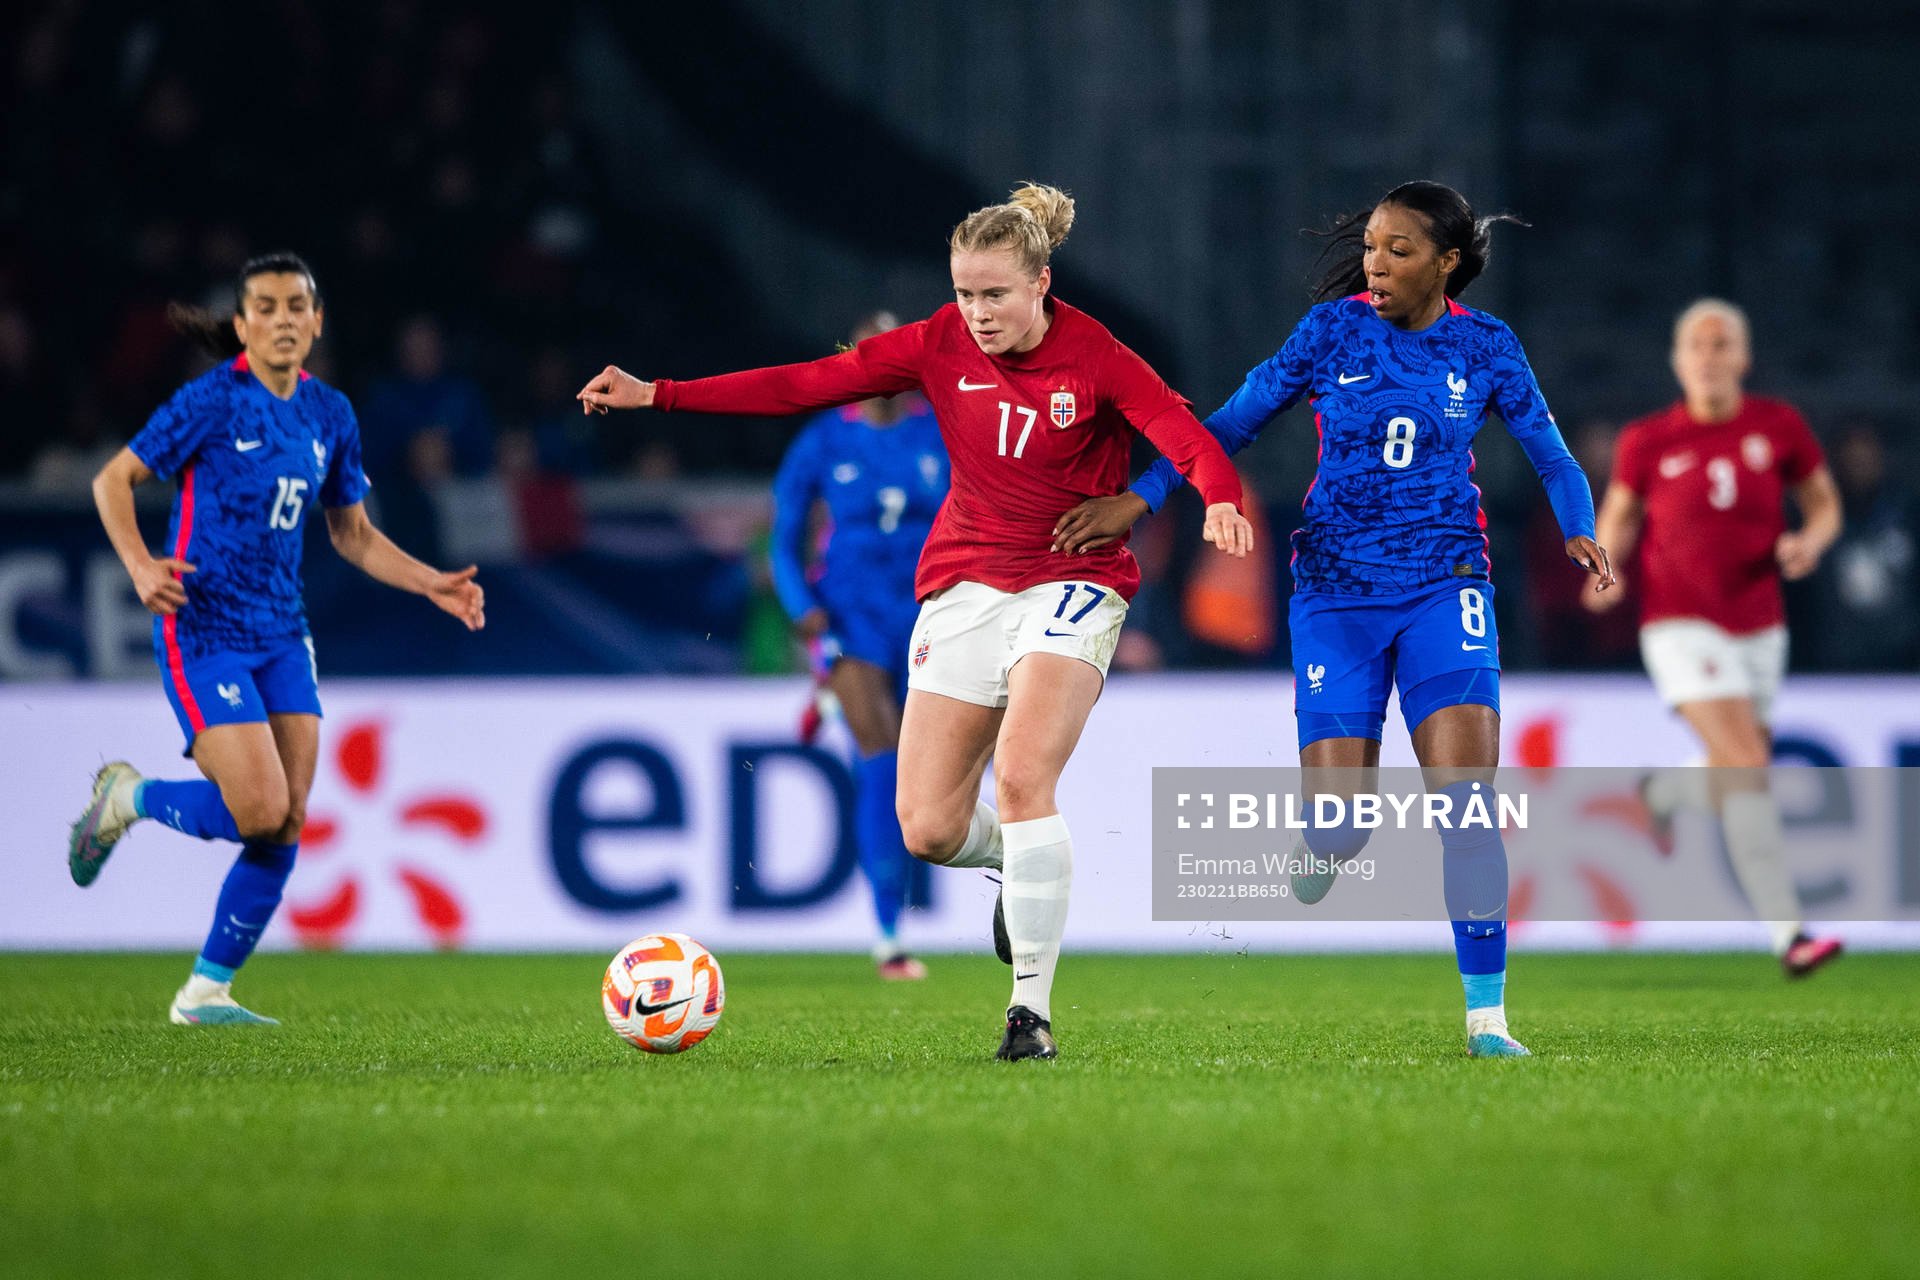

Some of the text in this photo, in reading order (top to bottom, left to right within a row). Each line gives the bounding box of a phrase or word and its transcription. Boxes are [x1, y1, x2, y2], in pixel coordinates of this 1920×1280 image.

[998, 401, 1038, 459] 17
[1383, 416, 1416, 468] 8
[269, 476, 308, 530] 15
[878, 486, 906, 534] 7
[1706, 455, 1738, 512] 3
[1054, 584, 1107, 625] 17
[1459, 587, 1486, 638] 8
[548, 738, 938, 914] eD
